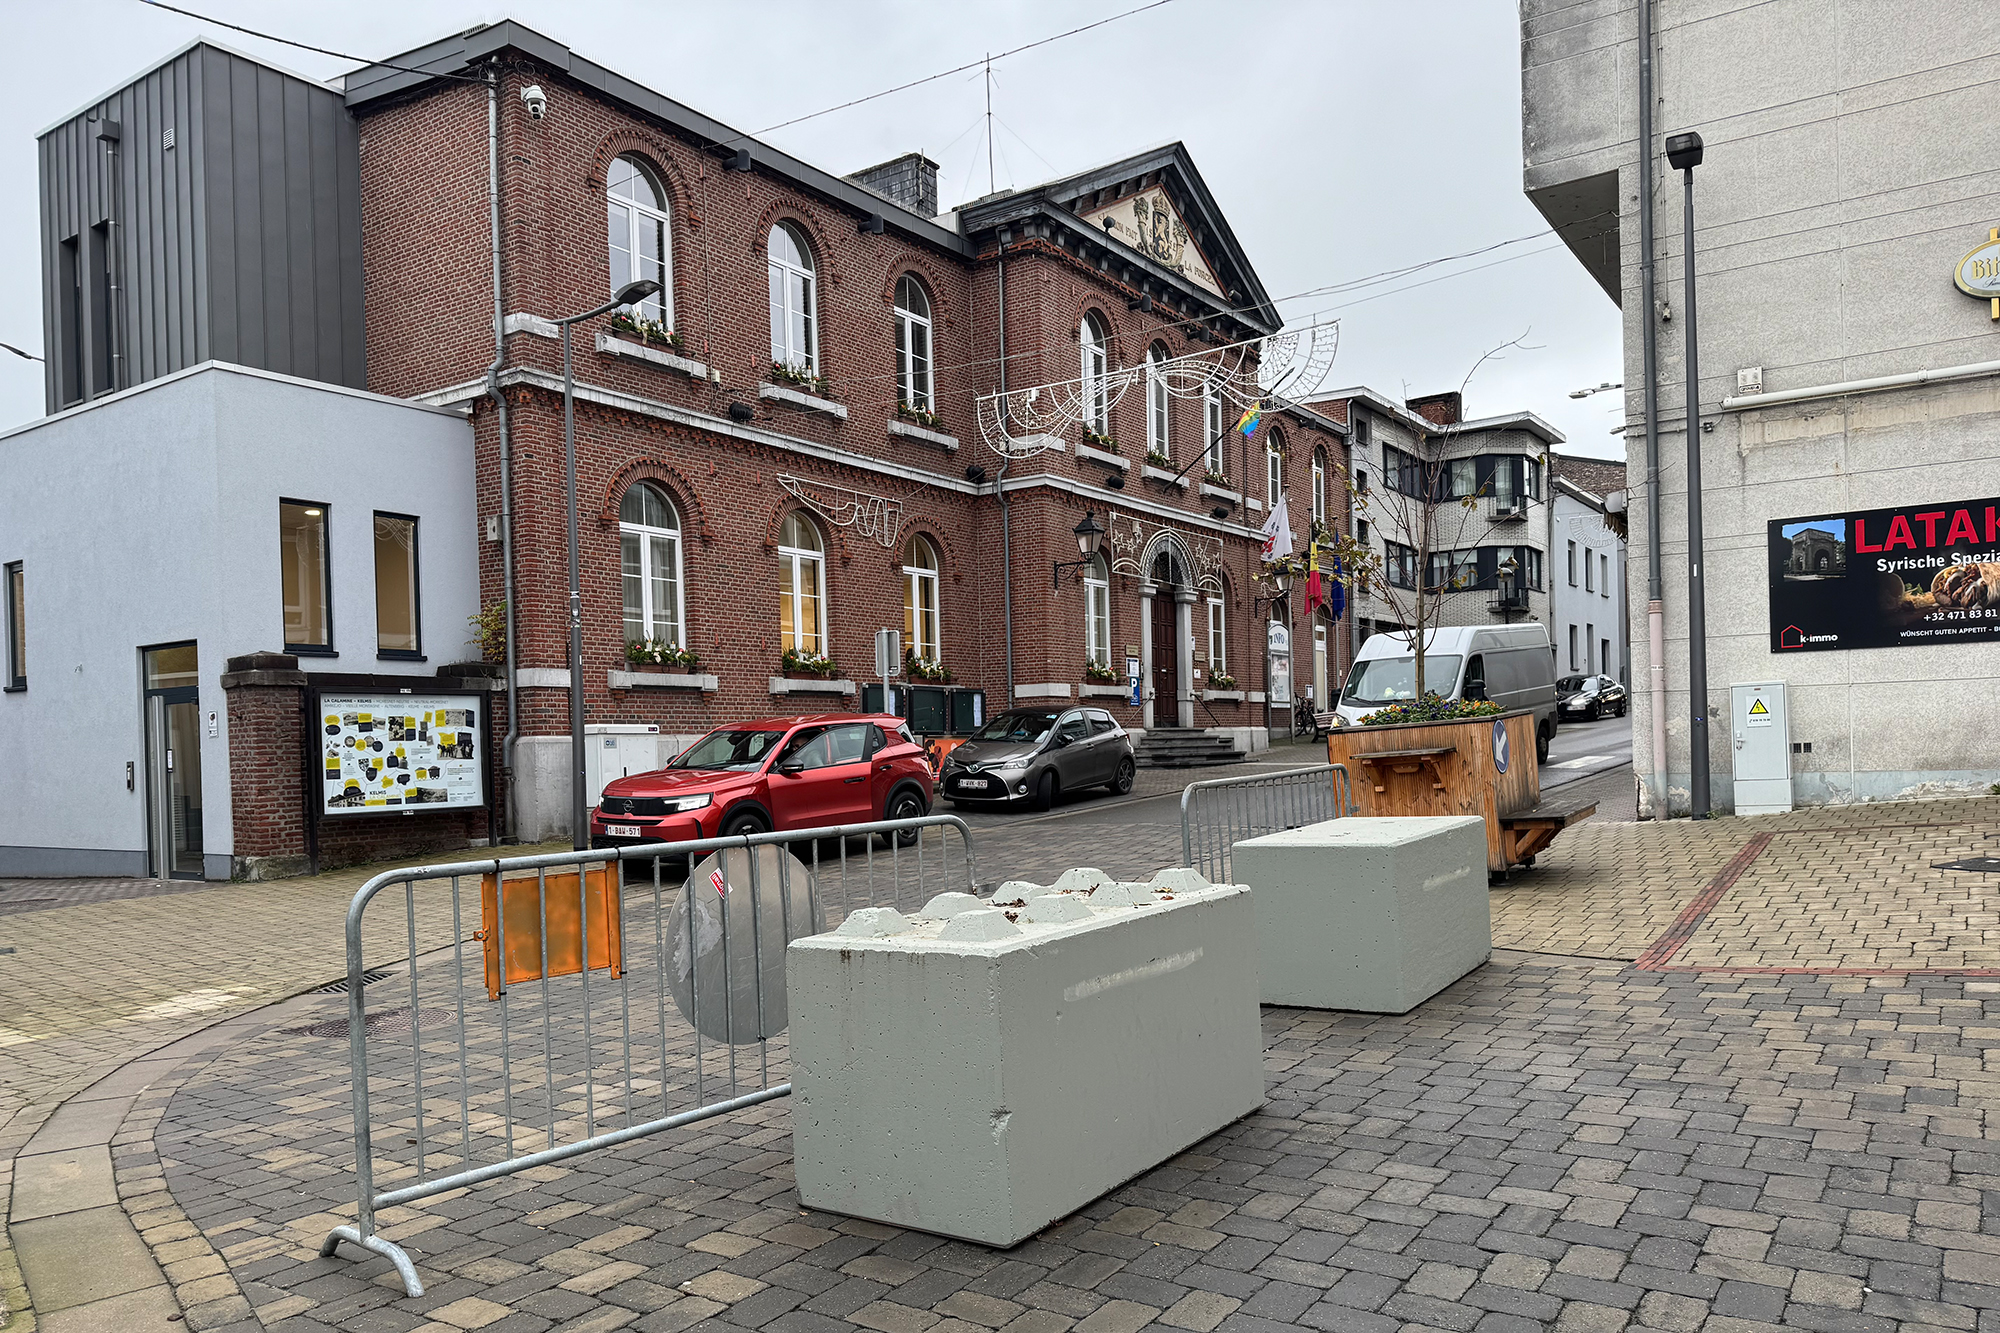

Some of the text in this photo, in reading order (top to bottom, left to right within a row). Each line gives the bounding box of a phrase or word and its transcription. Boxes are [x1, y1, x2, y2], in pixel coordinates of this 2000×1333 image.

[1876, 555, 1945, 574] Syrische
[1923, 608, 1998, 622] +32 471 83 81
[1273, 632, 1285, 645] INFO
[1899, 629, 1934, 638] WÜNSCHT
[1934, 628, 1958, 636] GUTEN
[1958, 626, 1988, 634] APPETIT
